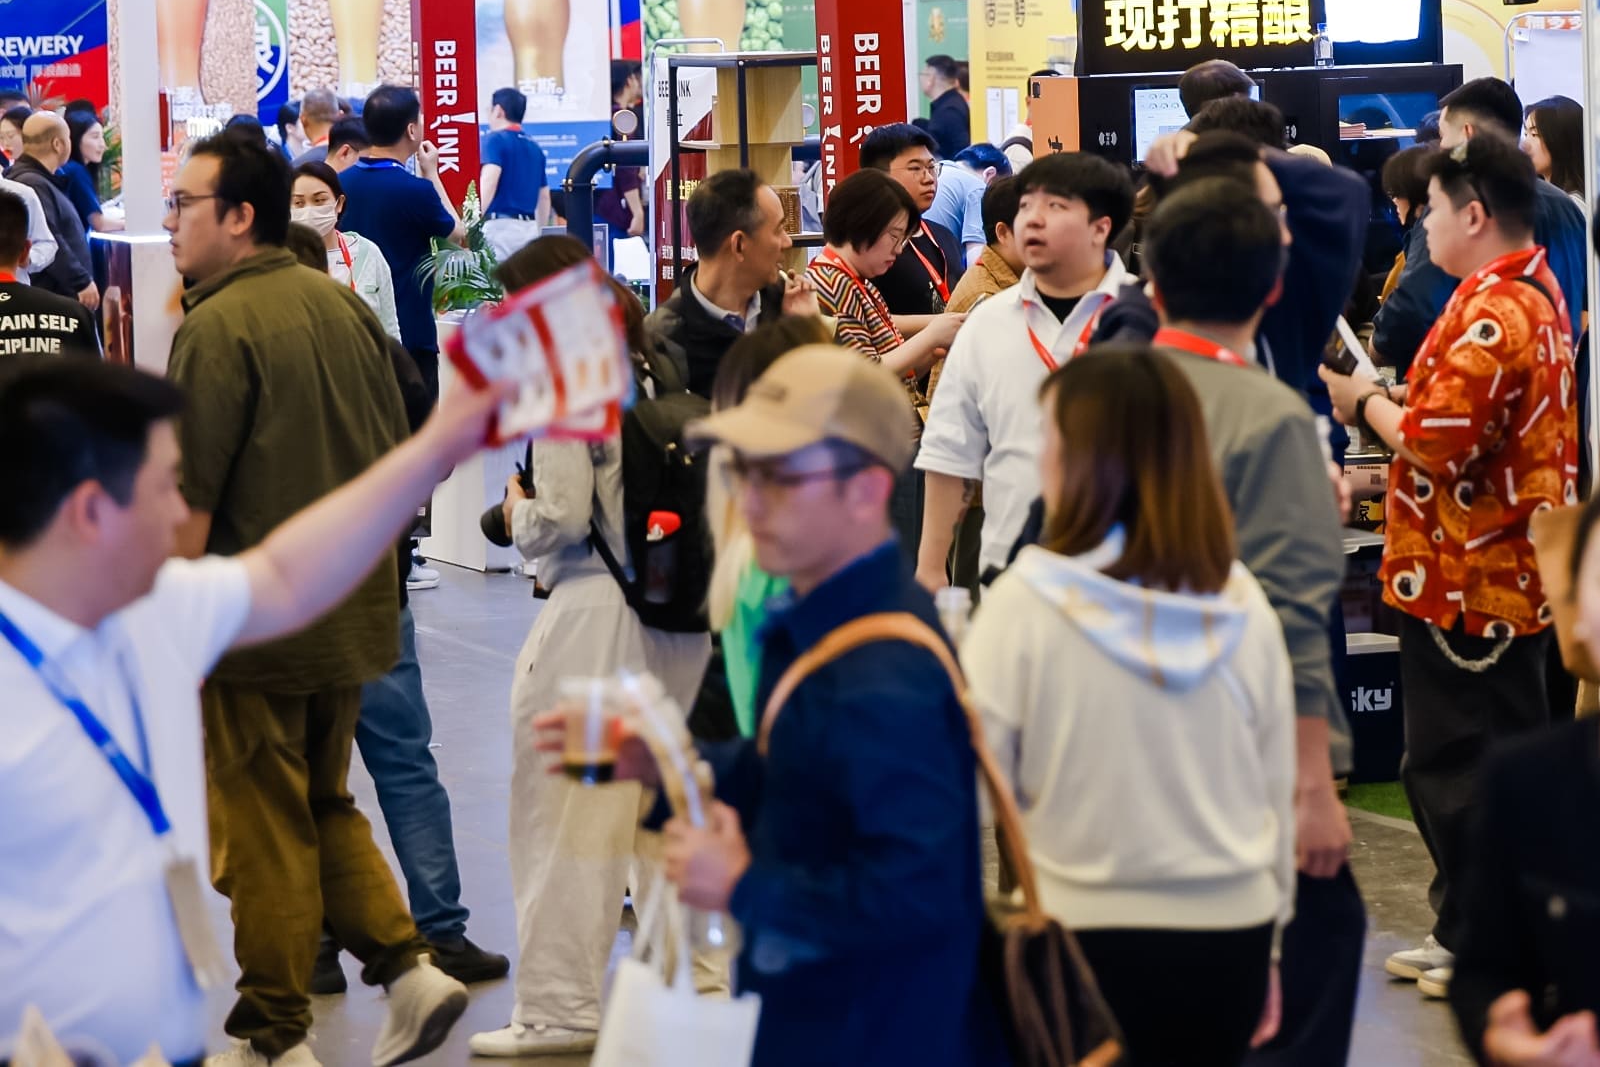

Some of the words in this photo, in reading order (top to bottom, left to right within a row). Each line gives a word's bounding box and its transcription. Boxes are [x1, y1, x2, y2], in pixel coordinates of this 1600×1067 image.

[435, 40, 458, 106] BEER
[820, 34, 833, 115] BEER
[854, 33, 881, 115] BEER
[0, 314, 36, 331] AIN
[39, 314, 79, 333] SELF
